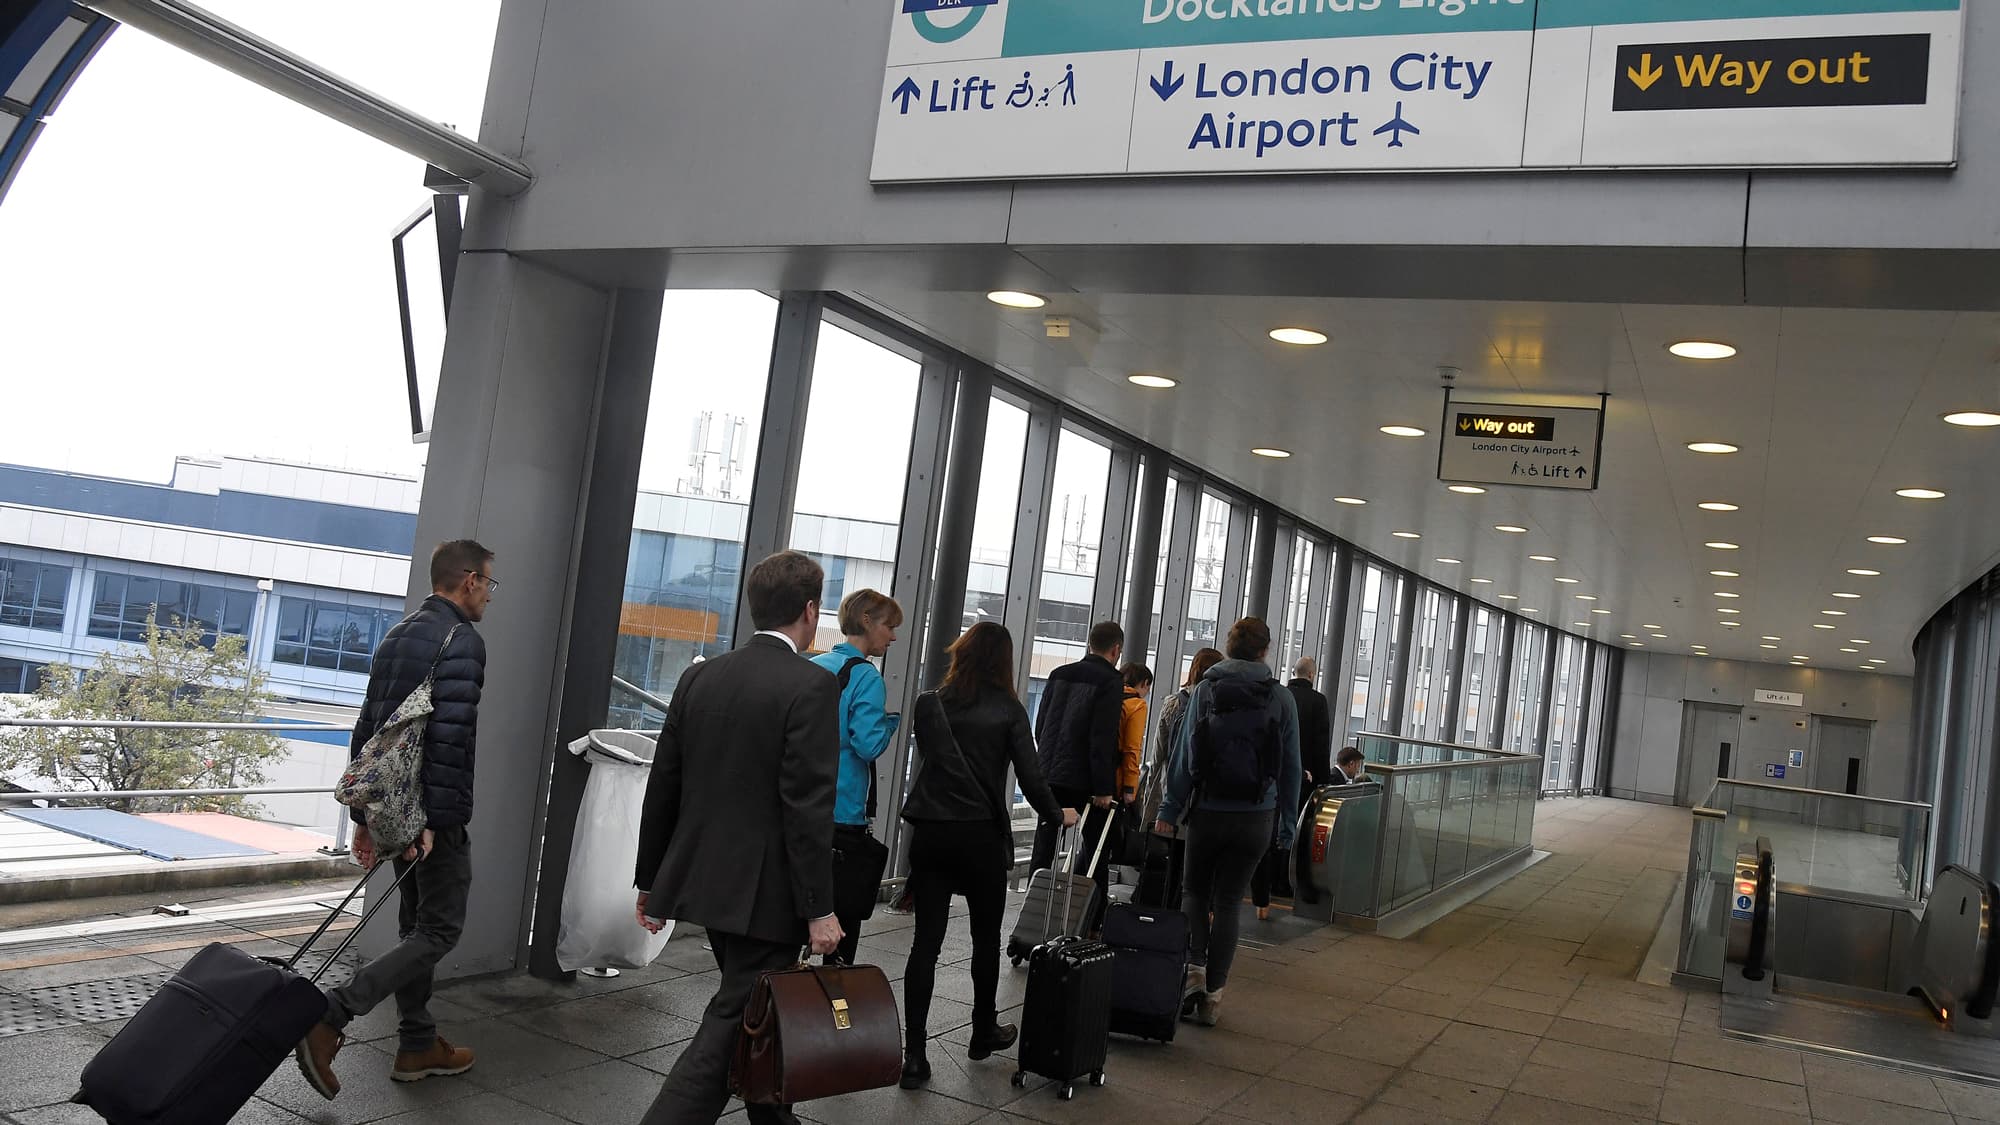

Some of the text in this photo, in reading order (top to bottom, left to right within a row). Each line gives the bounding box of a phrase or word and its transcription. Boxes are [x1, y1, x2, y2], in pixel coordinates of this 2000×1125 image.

[1195, 52, 1493, 99] London City
[1673, 51, 1871, 94] Way out
[928, 76, 996, 112] Lift
[1188, 112, 1358, 158] Airport
[1473, 418, 1535, 434] Way out
[1472, 442, 1567, 456] London City Airport
[1543, 465, 1569, 478] Lift
